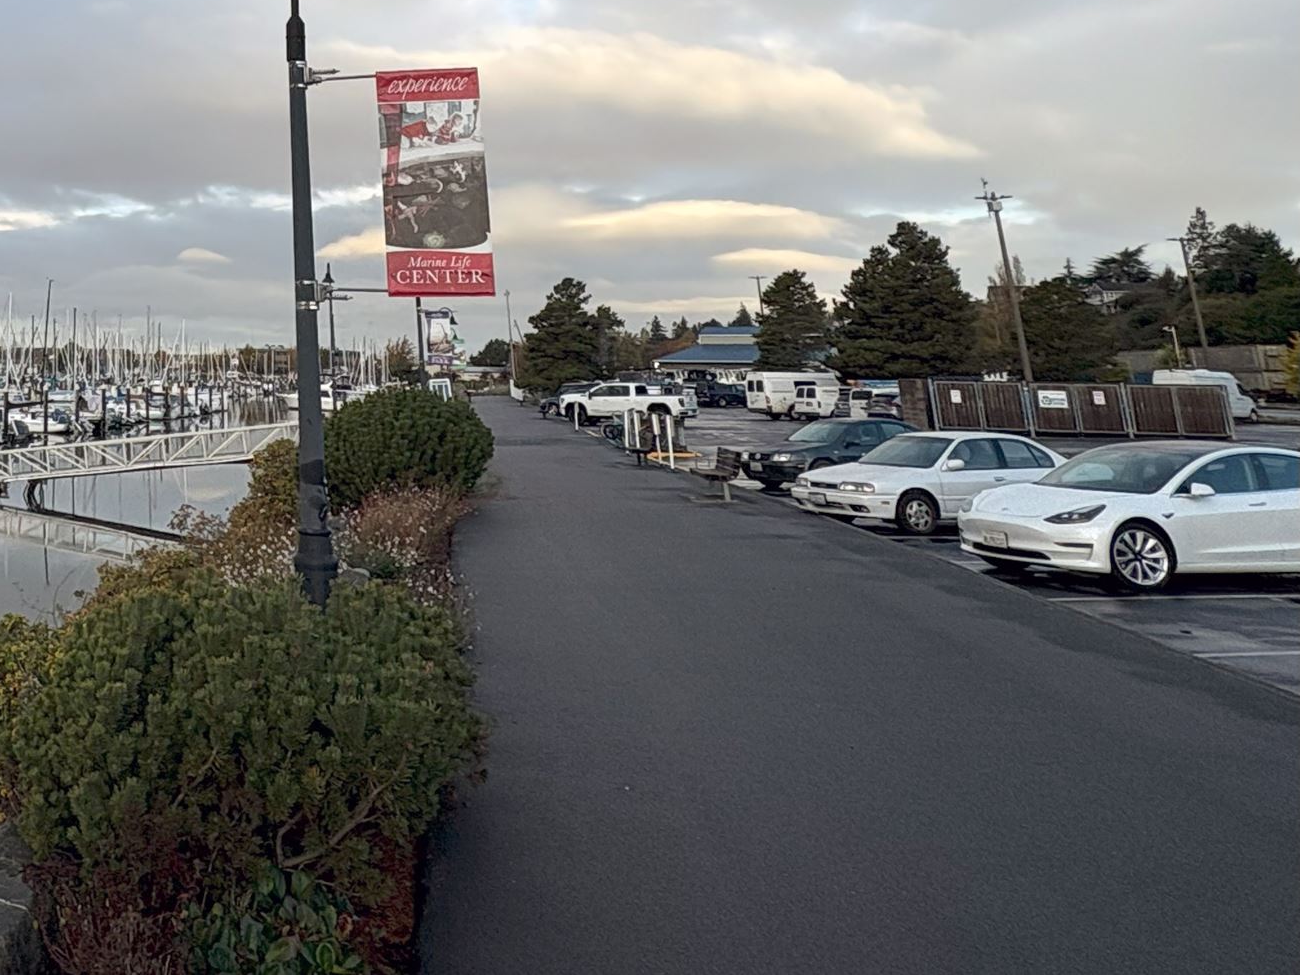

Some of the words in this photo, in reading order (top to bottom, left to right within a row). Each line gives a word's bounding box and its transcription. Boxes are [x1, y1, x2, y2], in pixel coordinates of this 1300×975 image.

[387, 76, 469, 100] experience
[408, 256, 447, 268] Marine
[450, 256, 472, 269] Life
[396, 269, 486, 284] CENTER
